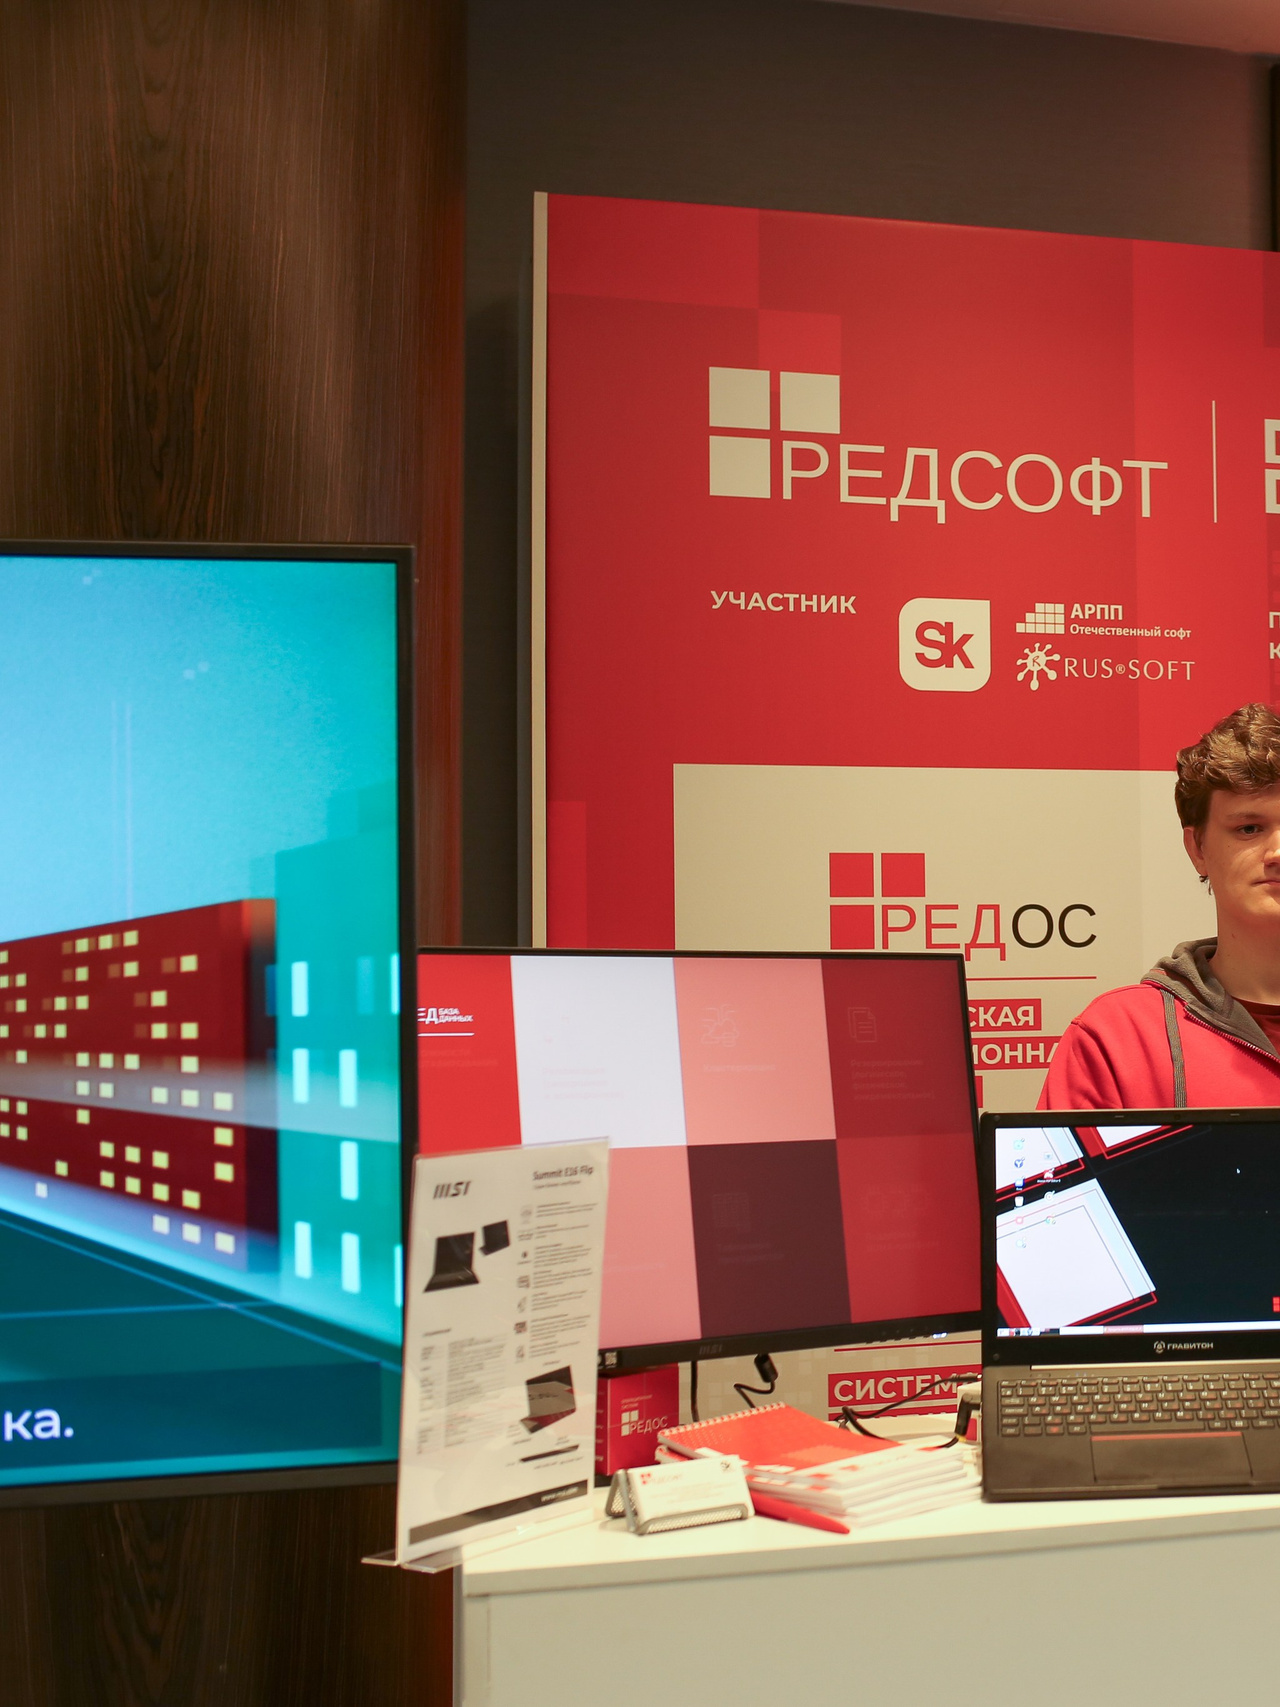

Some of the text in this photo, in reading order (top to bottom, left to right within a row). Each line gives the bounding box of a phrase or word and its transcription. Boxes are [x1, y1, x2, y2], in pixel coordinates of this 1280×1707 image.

[782, 440, 1168, 524] РЕДСОФТ
[710, 589, 857, 614] УЧАСТНИК
[1070, 603, 1123, 620] АРПП
[1070, 623, 1192, 640] Отечественный софт
[914, 620, 975, 669] Sk
[438, 1007, 460, 1016] БАЗА
[438, 1014, 474, 1024] ДАННЫХ
[532, 1166, 563, 1182] Summit
[432, 1179, 472, 1200] MSI
[1166, 1341, 1214, 1351] ГРАВИТОН
[834, 1371, 977, 1402] СИСТЕМ
